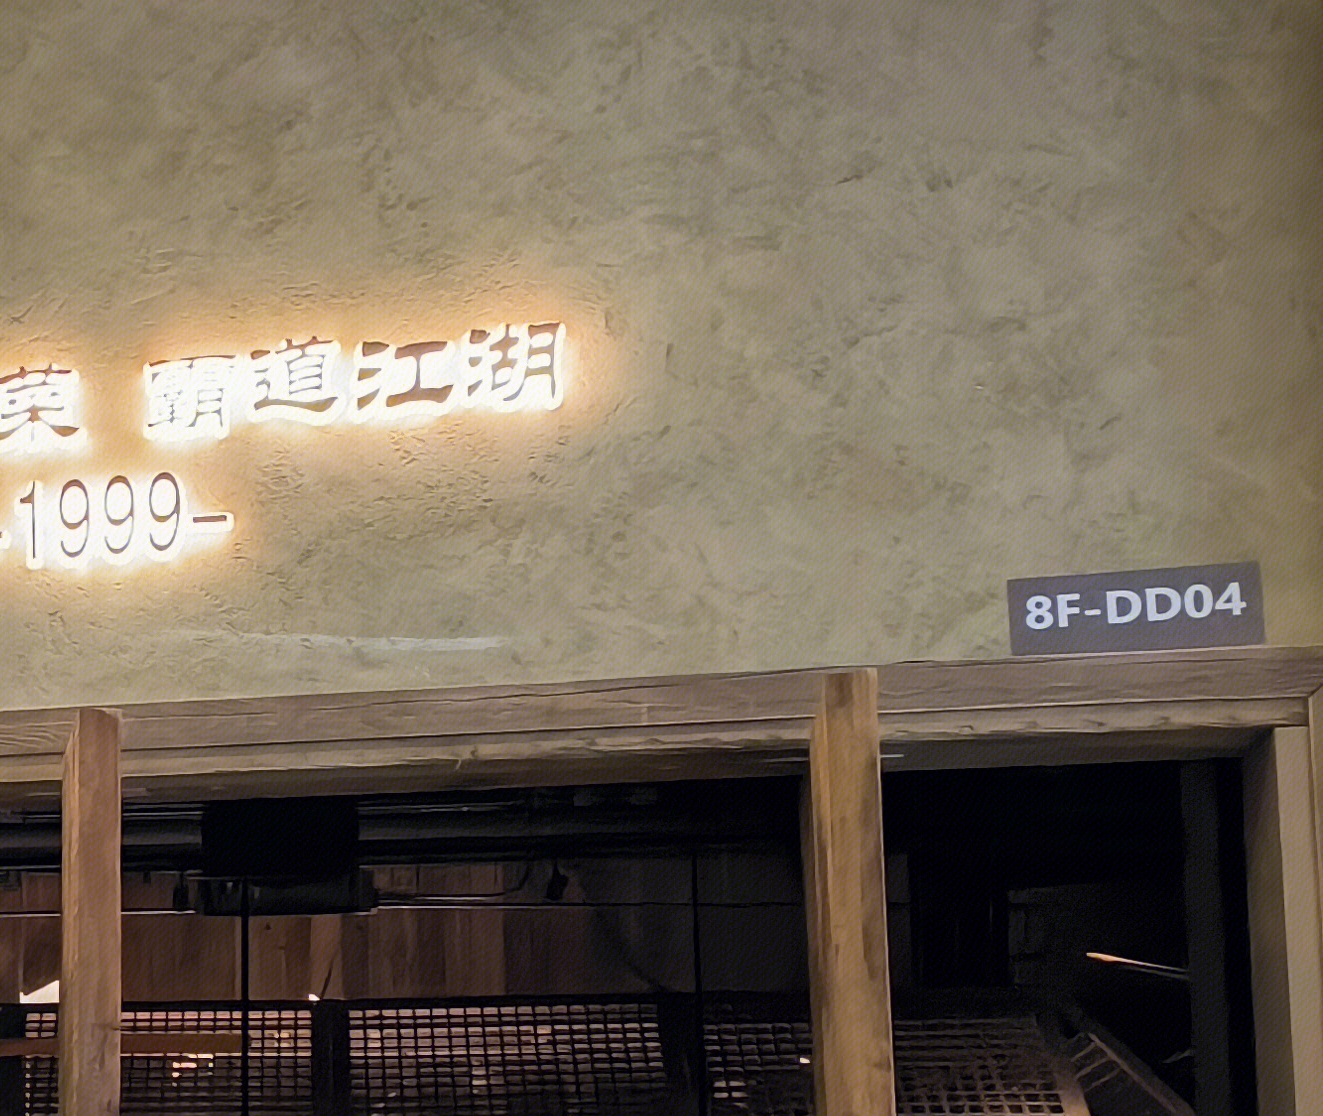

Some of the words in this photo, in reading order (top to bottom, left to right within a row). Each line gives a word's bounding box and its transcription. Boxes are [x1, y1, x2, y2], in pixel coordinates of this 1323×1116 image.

[144, 322, 561, 430] 霸道江湖
[1025, 582, 1247, 630] 8F-DD04
